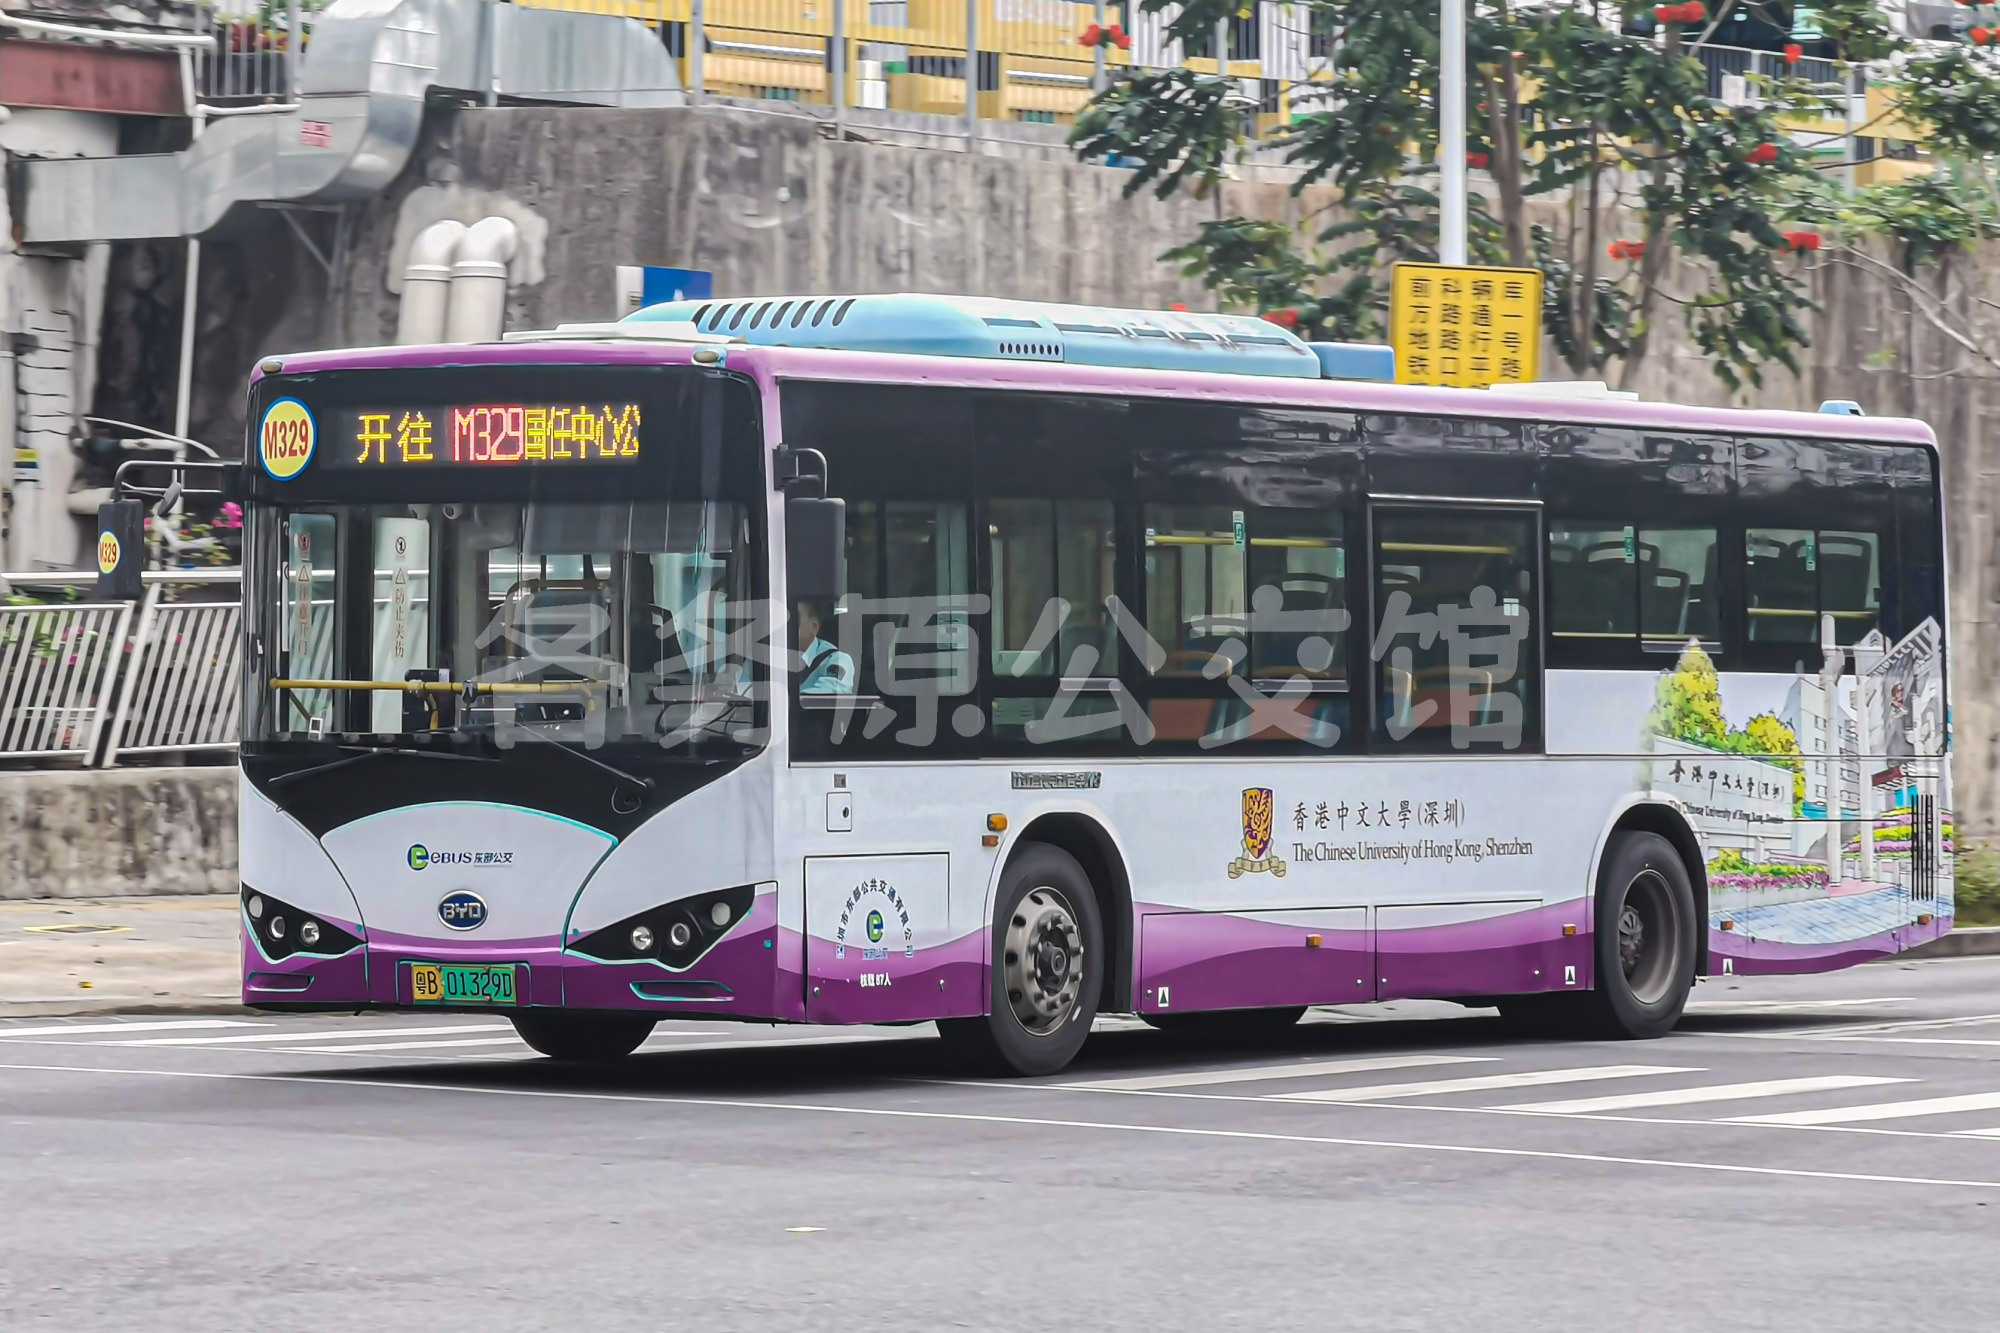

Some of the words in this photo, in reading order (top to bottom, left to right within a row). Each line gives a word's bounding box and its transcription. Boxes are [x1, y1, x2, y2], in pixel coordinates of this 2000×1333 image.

[1408, 276, 1432, 387] 前方地铁
[264, 419, 310, 460] M329
[356, 411, 434, 463] 开往
[99, 541, 117, 563] M329
[1292, 799, 1466, 832] 香港中文大學(深圳)
[1292, 842, 1314, 862] The
[1314, 841, 1357, 861] Chinese
[1357, 840, 1410, 865] University
[1411, 839, 1424, 859] of
[1424, 838, 1453, 864] Hong
[1454, 837, 1485, 863] Kong,
[1485, 836, 1534, 857] Shenzhen
[443, 902, 482, 919] BYD
